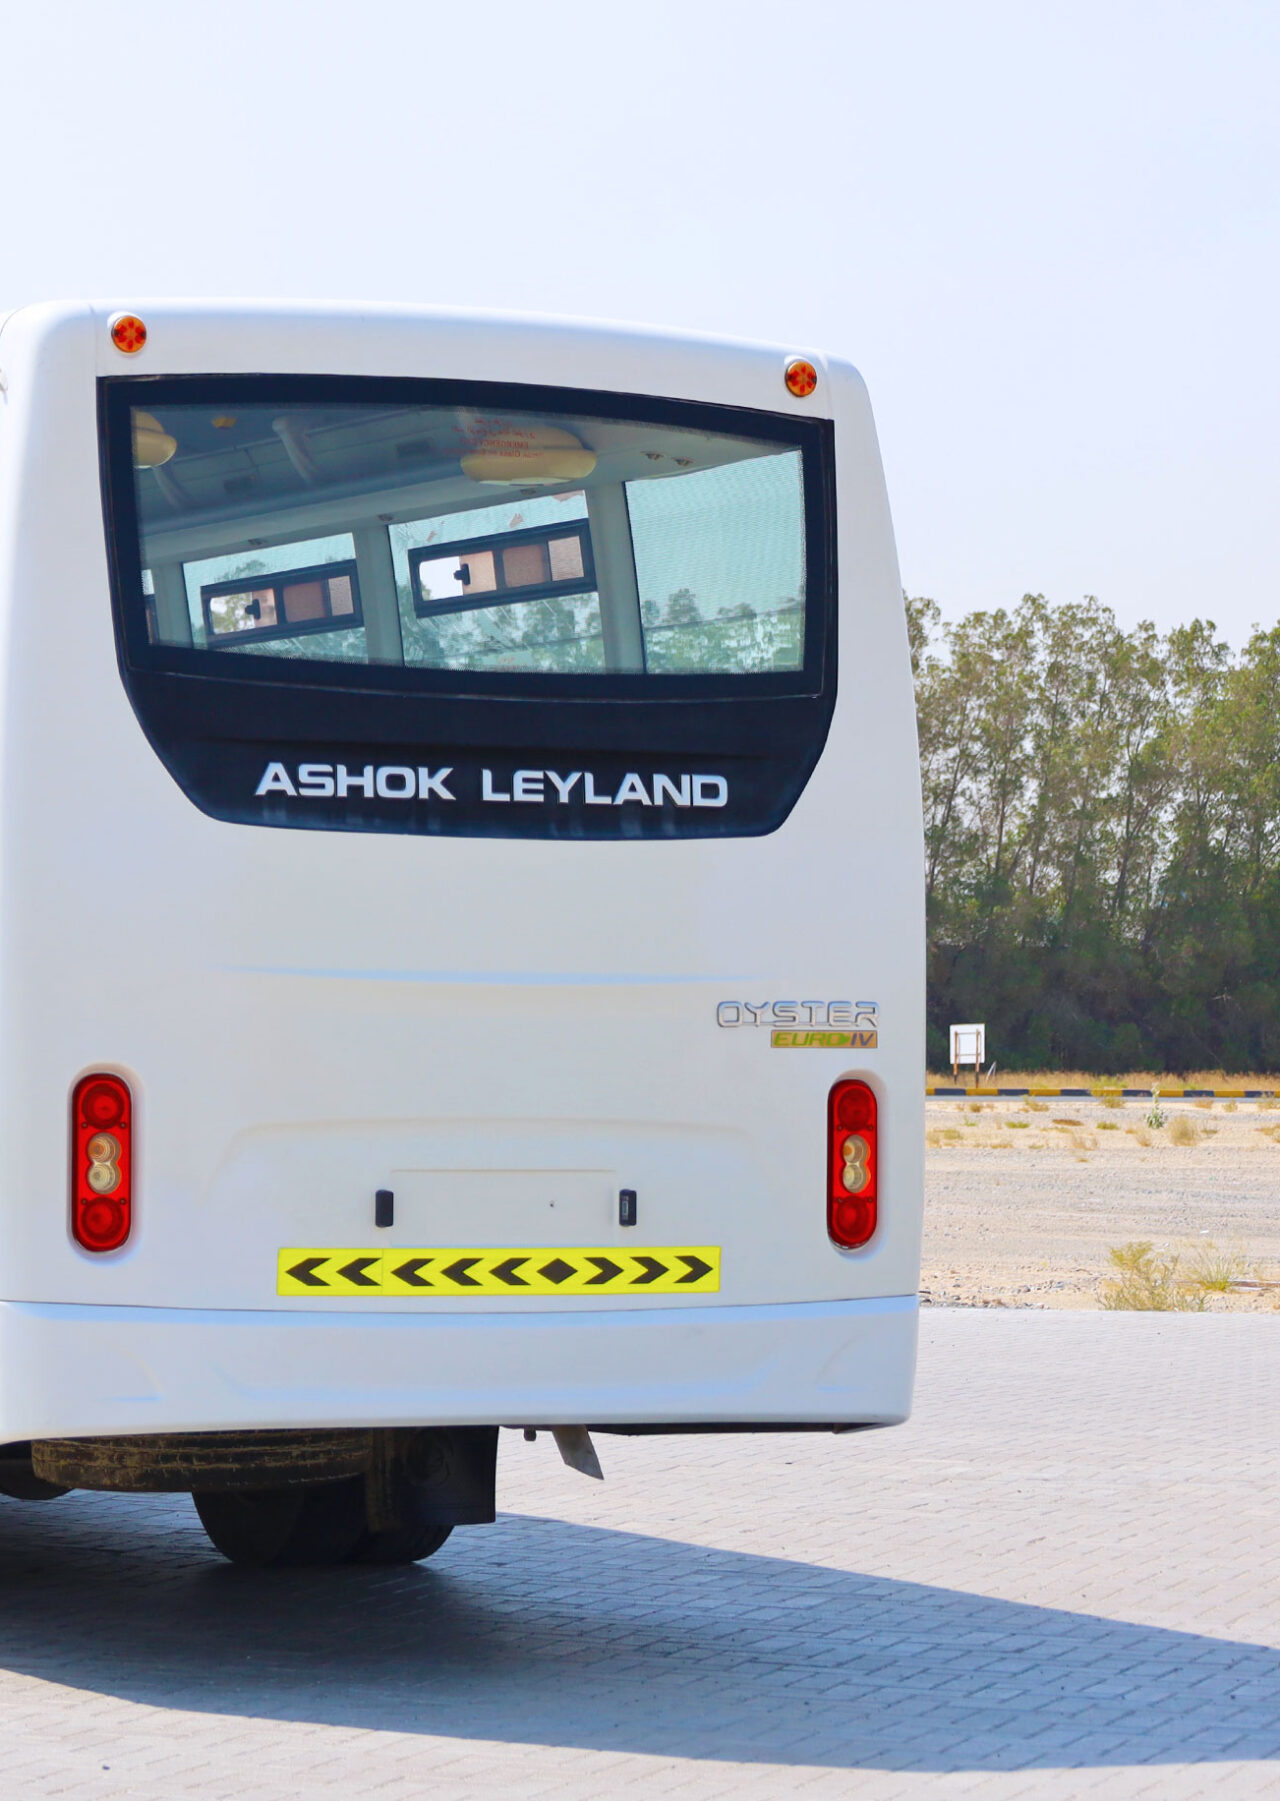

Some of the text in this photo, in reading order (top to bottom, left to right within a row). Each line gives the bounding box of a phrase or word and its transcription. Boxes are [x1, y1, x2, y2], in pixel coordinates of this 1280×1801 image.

[254, 762, 729, 808] ASHOK LEYLAND
[716, 1000, 881, 1027] OYSTER
[773, 1032, 874, 1047] EURO IV
